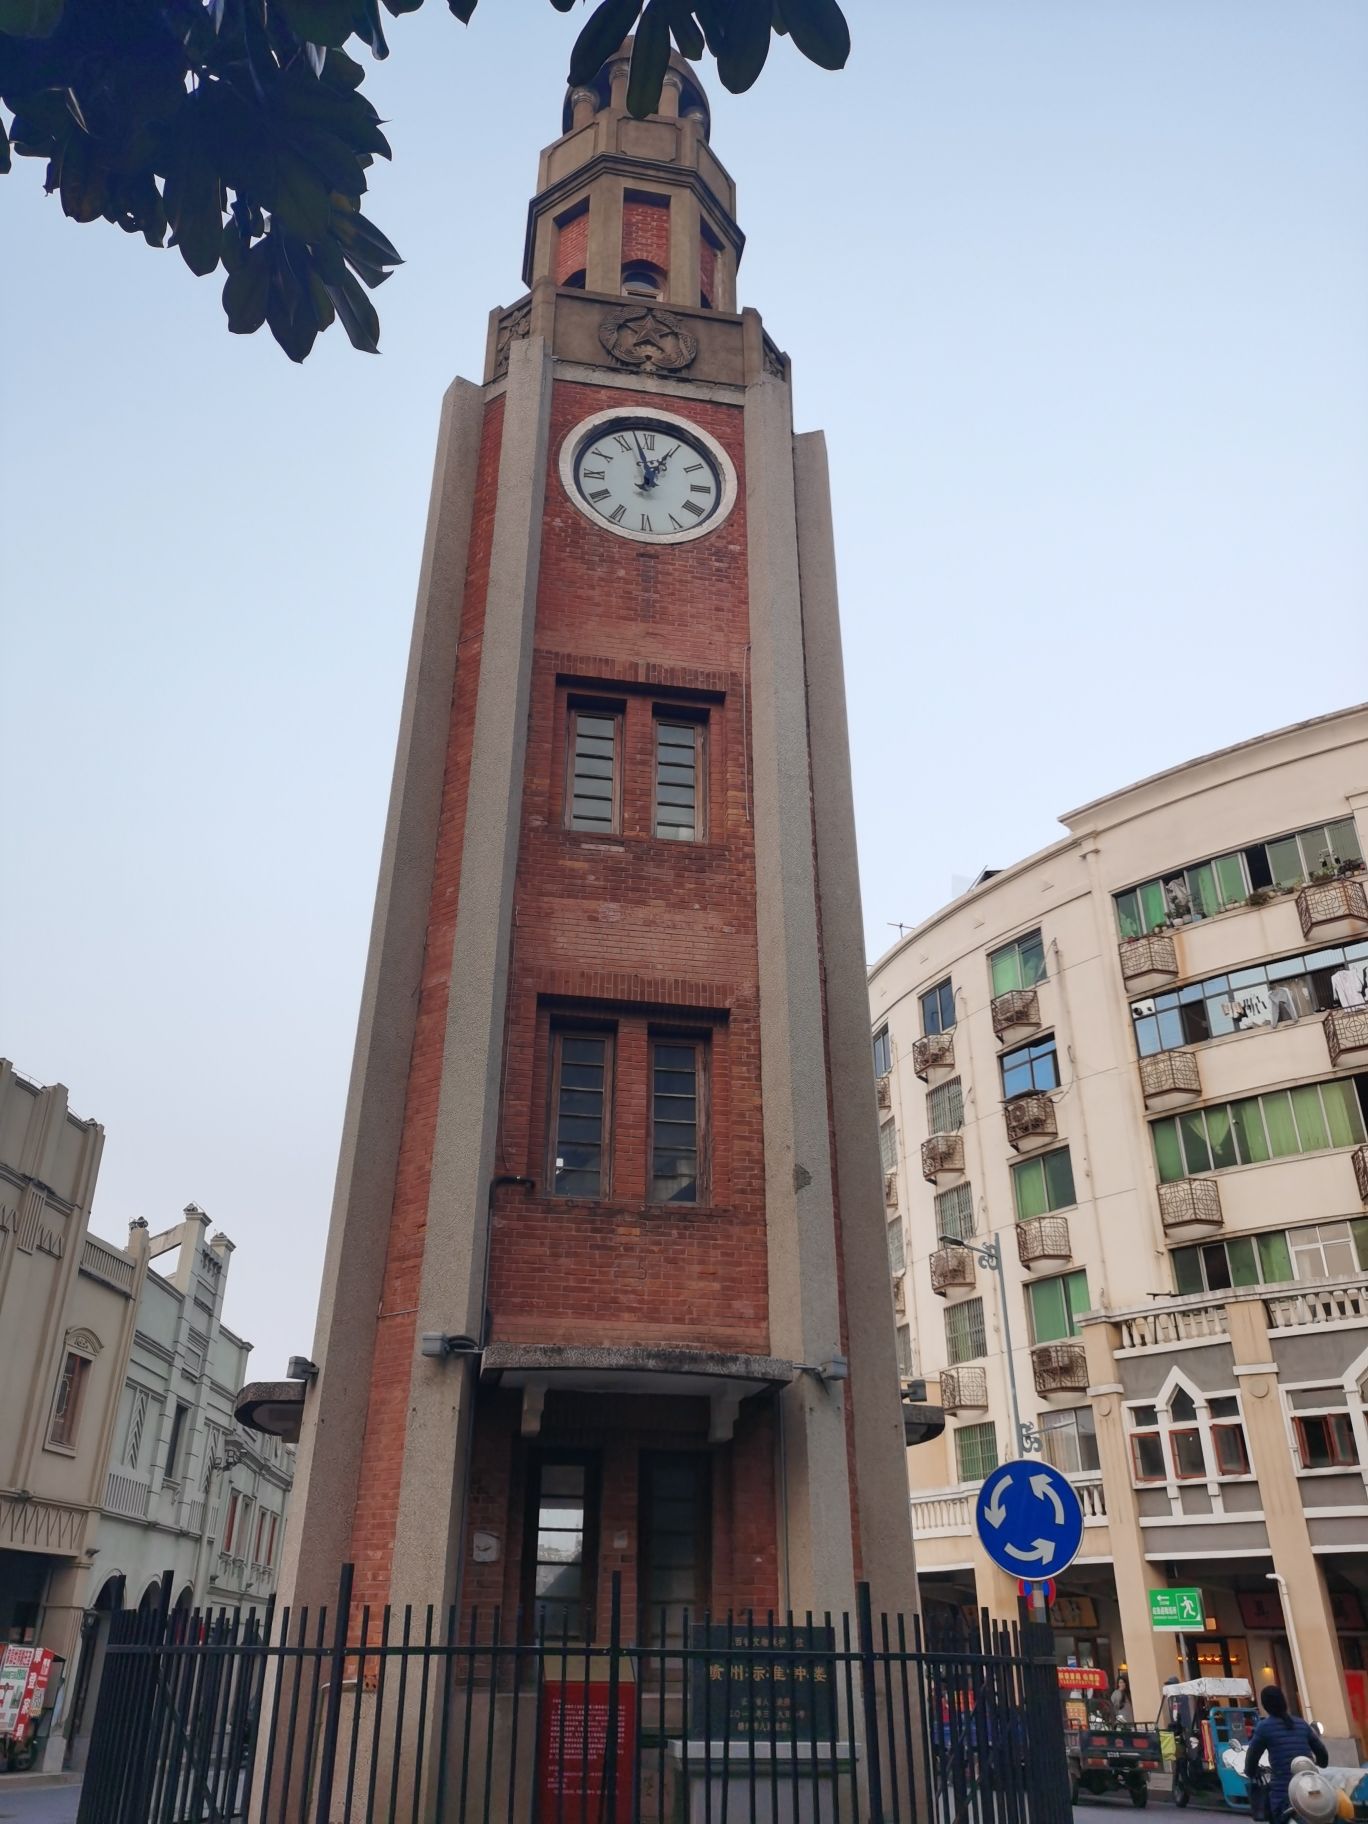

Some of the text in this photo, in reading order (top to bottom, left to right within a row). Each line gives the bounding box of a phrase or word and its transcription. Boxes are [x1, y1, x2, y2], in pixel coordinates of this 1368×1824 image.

[613, 434, 632, 452] XI
[642, 433, 655, 451] XII
[591, 447, 614, 463] X
[583, 468, 605, 480] IX
[683, 463, 704, 474] II
[589, 488, 612, 503] VIII
[690, 484, 711, 494] III
[609, 504, 627, 523] VII
[668, 513, 683, 530] V
[640, 513, 653, 532] VI
